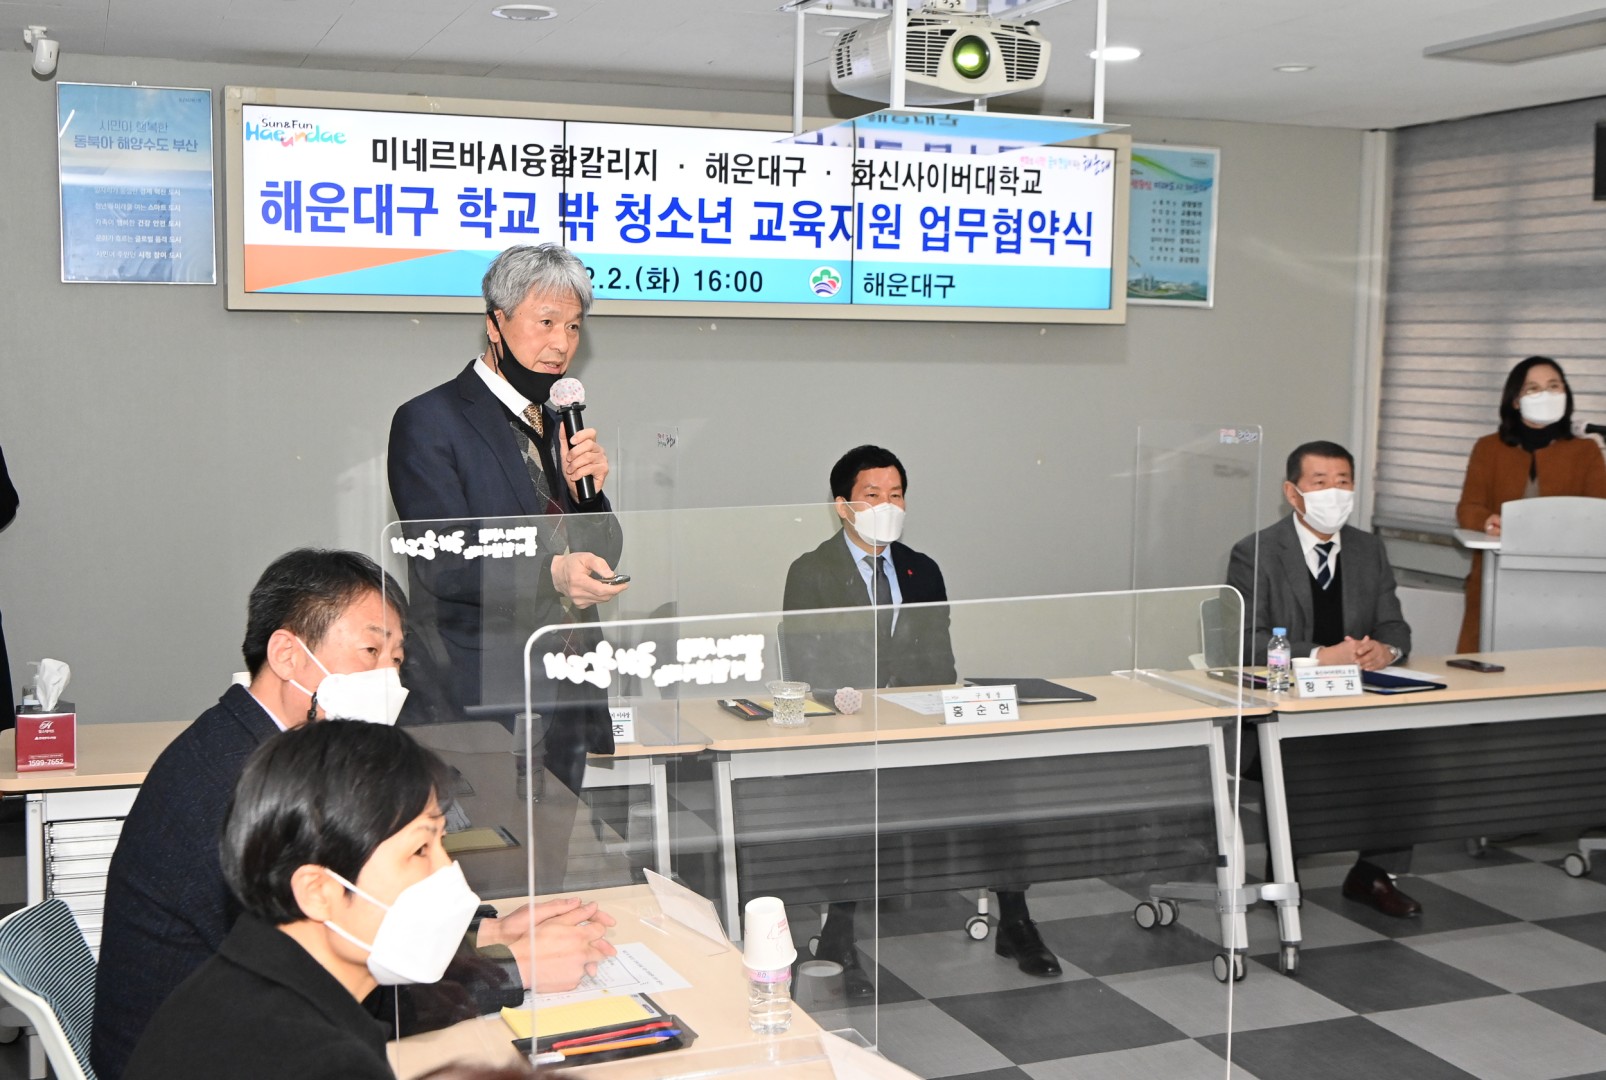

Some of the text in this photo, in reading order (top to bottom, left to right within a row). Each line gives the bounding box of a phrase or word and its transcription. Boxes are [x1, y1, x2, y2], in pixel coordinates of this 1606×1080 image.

[99, 119, 168, 134] 시민이 행복한
[245, 121, 347, 147] Haeundae
[262, 118, 313, 130] Sun&Fun
[74, 135, 198, 153] 동북아 해양수도 부산
[372, 136, 1042, 197] 미네르바AI융합칼리지 해운대구 화신사이버대학교
[260, 180, 439, 237] 해운대구
[457, 187, 540, 239] 학교
[558, 191, 599, 242] 밖
[615, 193, 732, 245] 청소년
[749, 200, 902, 250] 교육지원
[919, 205, 1093, 257] 업무협약식
[694, 269, 763, 293] 16:00
[863, 272, 956, 299] 해운대구
[28, 758, 64, 767] 1599-7652
